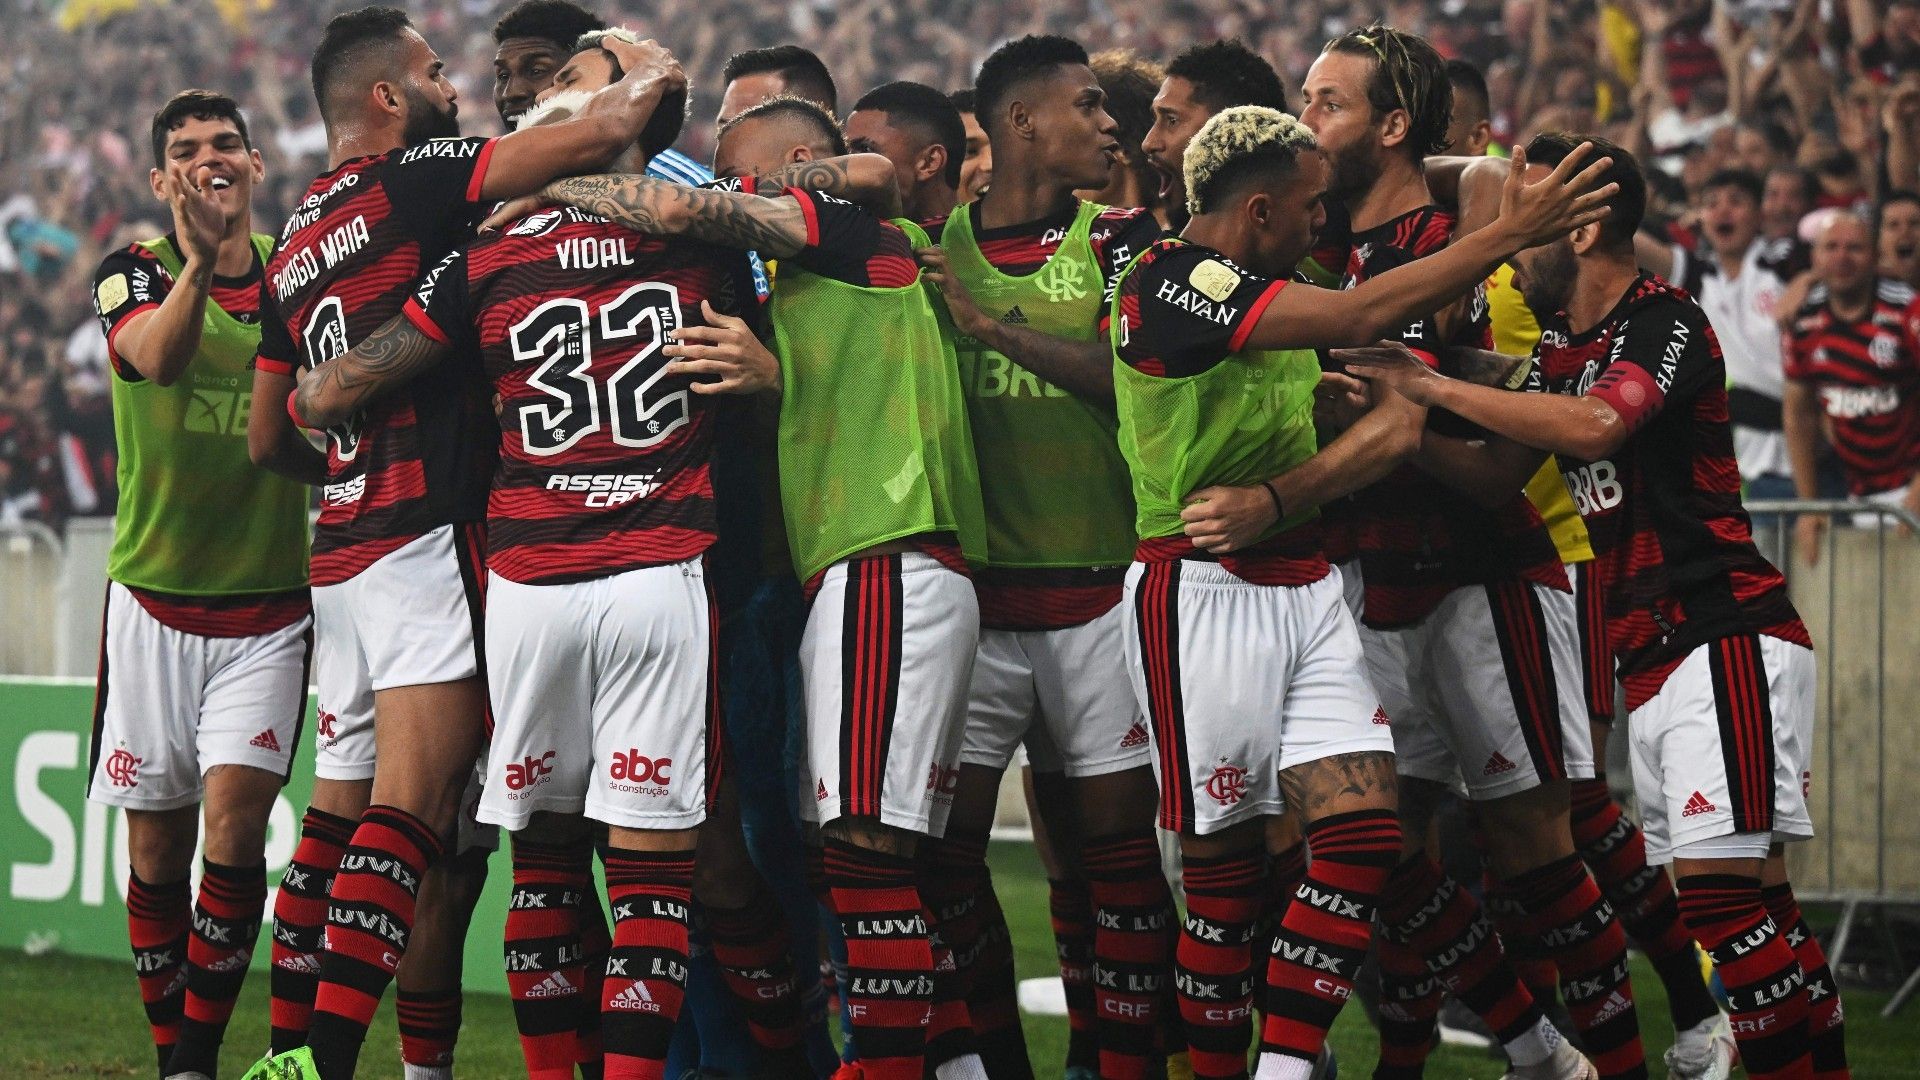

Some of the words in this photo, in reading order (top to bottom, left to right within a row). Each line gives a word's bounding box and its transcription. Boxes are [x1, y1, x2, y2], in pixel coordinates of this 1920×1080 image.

[400, 141, 480, 165] HAVAN
[273, 247, 320, 302] THIAGO
[319, 214, 370, 270] MAIA
[555, 236, 635, 269] VIDAL
[417, 250, 461, 313] AVAN
[1156, 278, 1238, 326] HAVAN
[509, 281, 690, 457] 32
[1655, 320, 1690, 394] HAVAN
[193, 373, 239, 387] banco
[1566, 459, 1624, 516] BRB
[505, 751, 556, 790] abc
[610, 748, 673, 786] abc
[507, 791, 519, 801] da
[608, 782, 618, 790] da
[618, 785, 669, 797] construção
[1682, 804, 1715, 817] adidas
[525, 985, 578, 999] adidas
[609, 998, 661, 1013] adidas
[1104, 998, 1151, 1019] CRF
